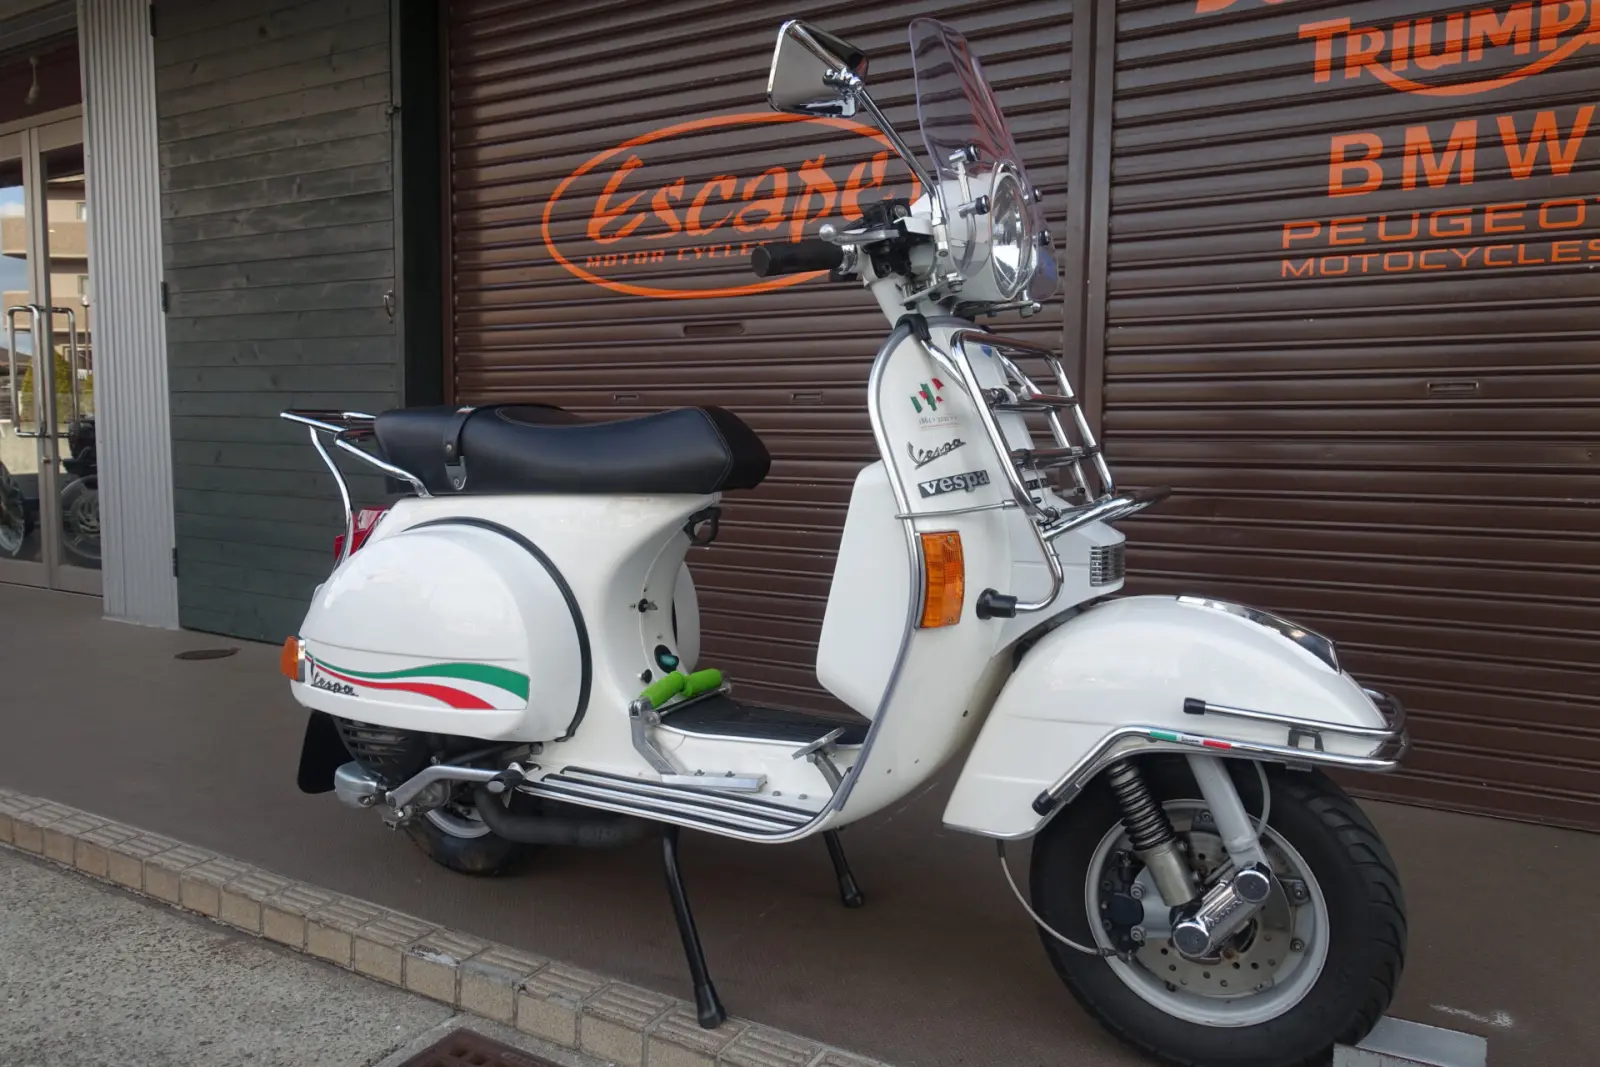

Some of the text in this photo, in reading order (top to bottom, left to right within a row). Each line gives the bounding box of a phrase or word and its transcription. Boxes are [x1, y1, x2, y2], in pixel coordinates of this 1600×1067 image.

[1298, 0, 1600, 96] TRIUMP
[1328, 105, 1596, 198] BMW
[587, 151, 895, 243] Escape
[1281, 196, 1600, 249] PEUGEO
[585, 240, 775, 268] MOTOR CYCLE
[907, 438, 966, 470] Vespa
[920, 470, 990, 494] vespa
[310, 657, 359, 697] Vespa
